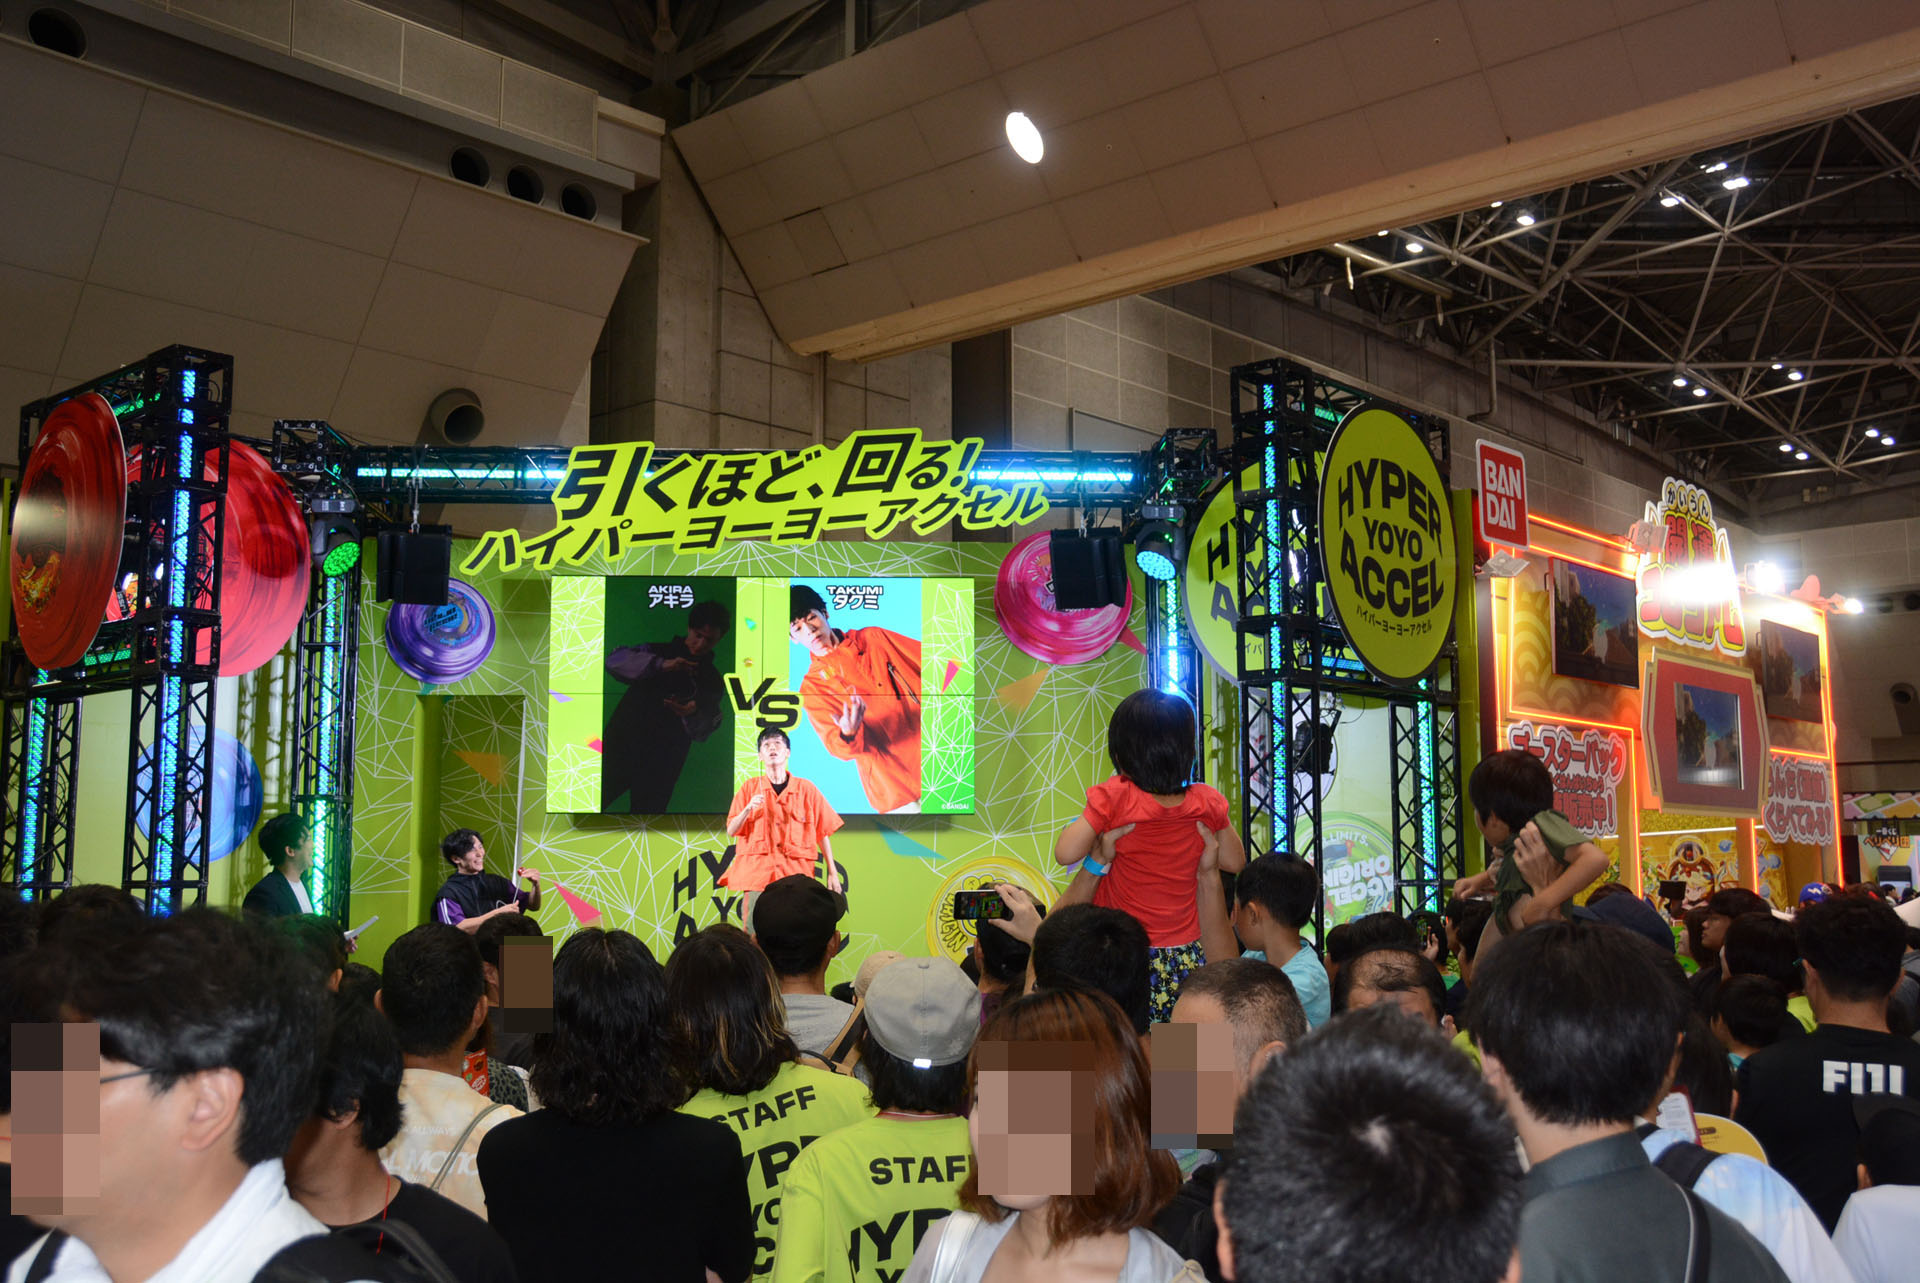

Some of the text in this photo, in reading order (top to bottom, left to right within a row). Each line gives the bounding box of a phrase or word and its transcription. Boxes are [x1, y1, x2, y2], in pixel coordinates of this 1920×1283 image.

[1484, 458, 1522, 500] BAN
[466, 486, 1044, 570] ハイパーヨーヨーアクセル
[1338, 458, 1443, 560] HYPER
[1486, 492, 1516, 531] DAI
[1362, 516, 1423, 563] YOYO
[648, 585, 693, 595] AKIRA
[827, 586, 883, 596] TAKUMI
[1340, 528, 1444, 618] ACCEL
[648, 594, 694, 609] アキラ
[833, 595, 880, 610] タクミ
[1356, 605, 1432, 637] ハイパーヨーヨーアクセル
[728, 677, 800, 729] VS
[869, 1154, 972, 1185] STAF
